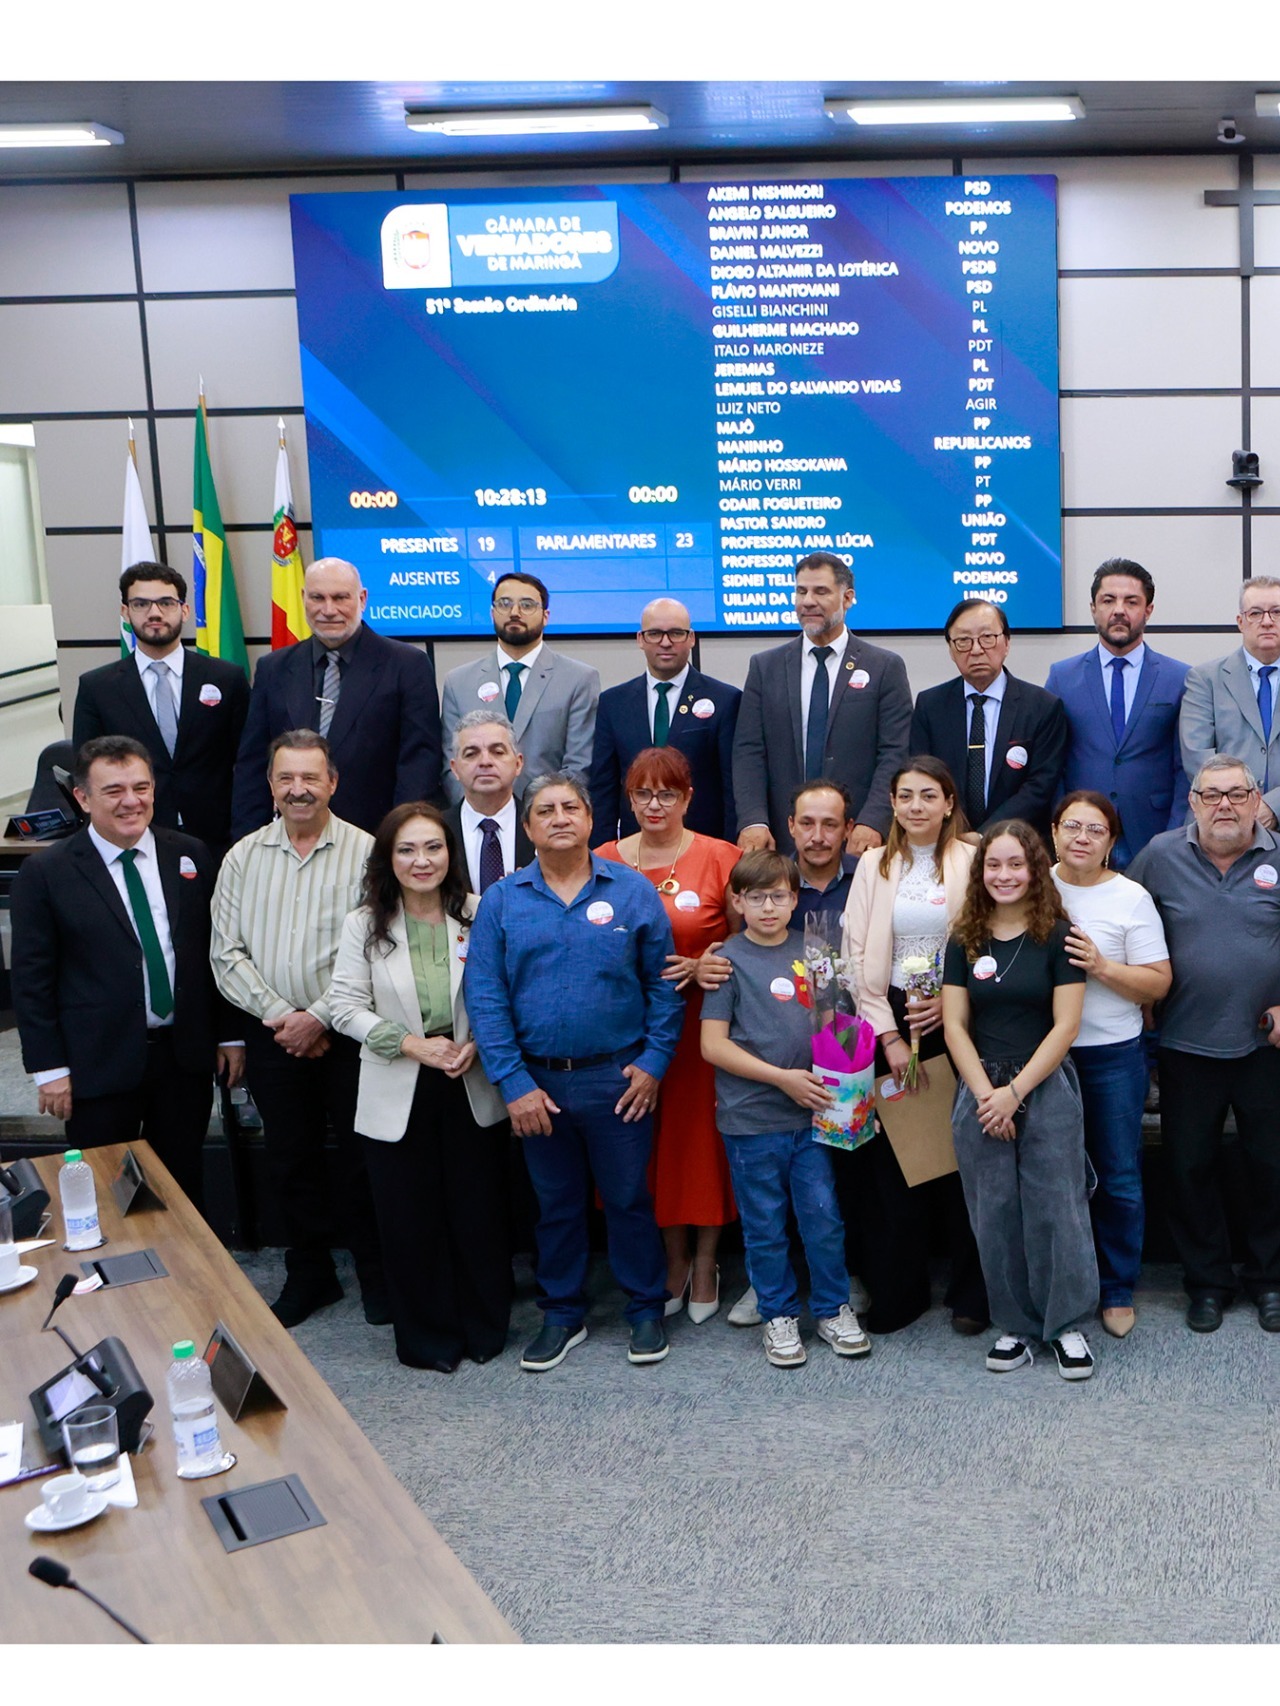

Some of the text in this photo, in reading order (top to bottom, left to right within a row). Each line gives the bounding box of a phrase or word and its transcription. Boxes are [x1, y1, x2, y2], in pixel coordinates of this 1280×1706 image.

[707, 185, 823, 201] AKEMI NISHIMORI
[965, 181, 990, 195] PSD
[708, 204, 836, 221] ANGELO SALGUEIRO
[945, 201, 1011, 215] PODEMOS
[485, 215, 581, 233] CÂMARA DE
[970, 221, 987, 235] PP
[709, 224, 809, 241] BRAVIN JUNIOR
[456, 231, 613, 257] VEREADORES
[959, 240, 999, 254] NOVO
[710, 244, 823, 260] DANIEL MALVEZZI
[487, 253, 582, 271] DE MARINGÁ
[962, 260, 996, 274] PSDB
[711, 260, 899, 279] DIOGO ALTAMIR DA LOTÉRICA
[712, 283, 840, 299] FLÁVIO MANTOVANI
[967, 280, 992, 293] PSD
[453, 297, 504, 313] Sessão
[506, 294, 577, 312] Ordinária
[712, 304, 828, 317] GISELLI BIANCHINI
[973, 300, 987, 312] PL
[713, 322, 859, 338] GUILHERME MACHADO
[972, 320, 988, 333] PL
[715, 343, 824, 356] ITALO MARONEZE
[969, 339, 992, 351] PDT
[715, 362, 775, 377] JEREMIAS
[973, 358, 989, 372] PL
[716, 379, 901, 396] LEMUEL DO SALVANDO VIDAS
[969, 378, 994, 391] PDT
[717, 402, 780, 414] LUIZ NETO
[966, 398, 996, 410] AGIR
[717, 419, 754, 434] MAJÔ
[974, 417, 990, 430] PP
[718, 440, 783, 453] MANINHO
[934, 436, 1031, 450] REPUBLICANOS
[718, 458, 847, 472] MÁRIO HOSSOKAWA
[975, 456, 991, 468] PP
[720, 477, 800, 491] MÁRIO VERRI
[976, 476, 991, 487] PT
[350, 491, 397, 508] 00:00
[475, 488, 546, 506] 10:28:13
[629, 486, 677, 502] 00:00
[976, 494, 992, 507] PP
[719, 497, 842, 511] ODAIR FOGUETEIRO
[721, 516, 826, 530] PASTOR SANDRO
[962, 512, 1006, 526] UNIÃO
[381, 537, 458, 553] PRESENTES
[478, 537, 495, 551] 19
[536, 534, 656, 550] PARLAMENTARES
[676, 533, 693, 547] 23
[722, 533, 873, 549] PROFESSORA ANA LÚCIA
[972, 533, 997, 545] PDT
[722, 555, 794, 568] PROFESSOR
[965, 552, 1005, 564] NOVO
[390, 572, 459, 585] AUSENTES
[487, 570, 496, 584] 4
[723, 574, 764, 587] SIDNEI
[954, 571, 1018, 584] PODEMOS
[723, 593, 766, 606] UILIAN
[769, 593, 788, 605] DA
[963, 588, 1008, 603] UNIÃO
[371, 606, 461, 618] LICENCIADOS
[724, 612, 779, 624] WILLIAM
